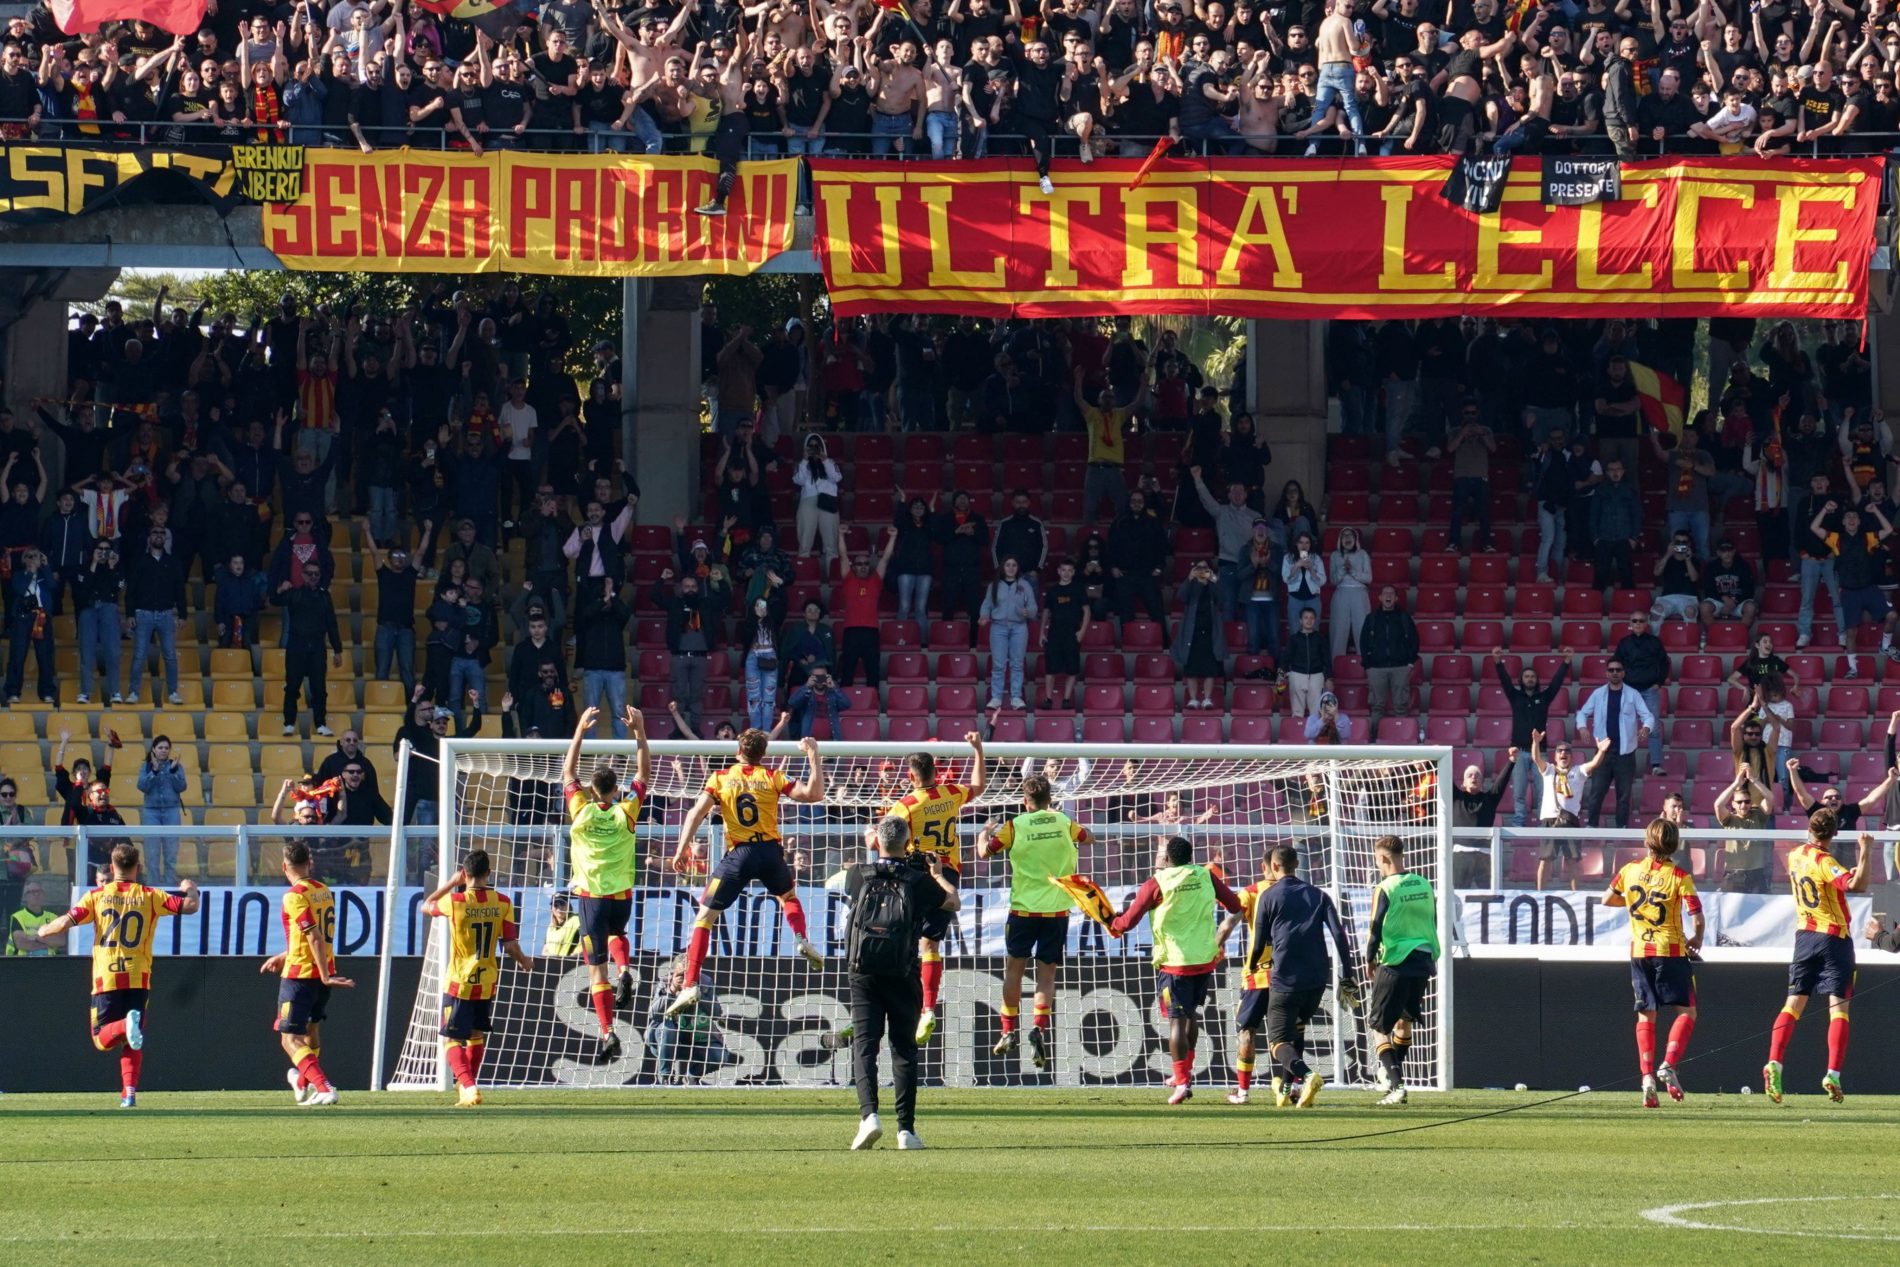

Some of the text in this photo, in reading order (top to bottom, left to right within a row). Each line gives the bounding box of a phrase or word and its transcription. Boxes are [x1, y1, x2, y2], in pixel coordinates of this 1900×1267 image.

[1550, 178, 1614, 198] PRESENTE
[270, 163, 491, 259] SENZA
[1378, 181, 1856, 290] LECCE
[736, 792, 759, 827] 6
[1628, 885, 1667, 927] 25
[1790, 870, 1822, 909] 10
[100, 907, 145, 949] 20
[315, 905, 336, 944] 16
[471, 921, 494, 961] 11
